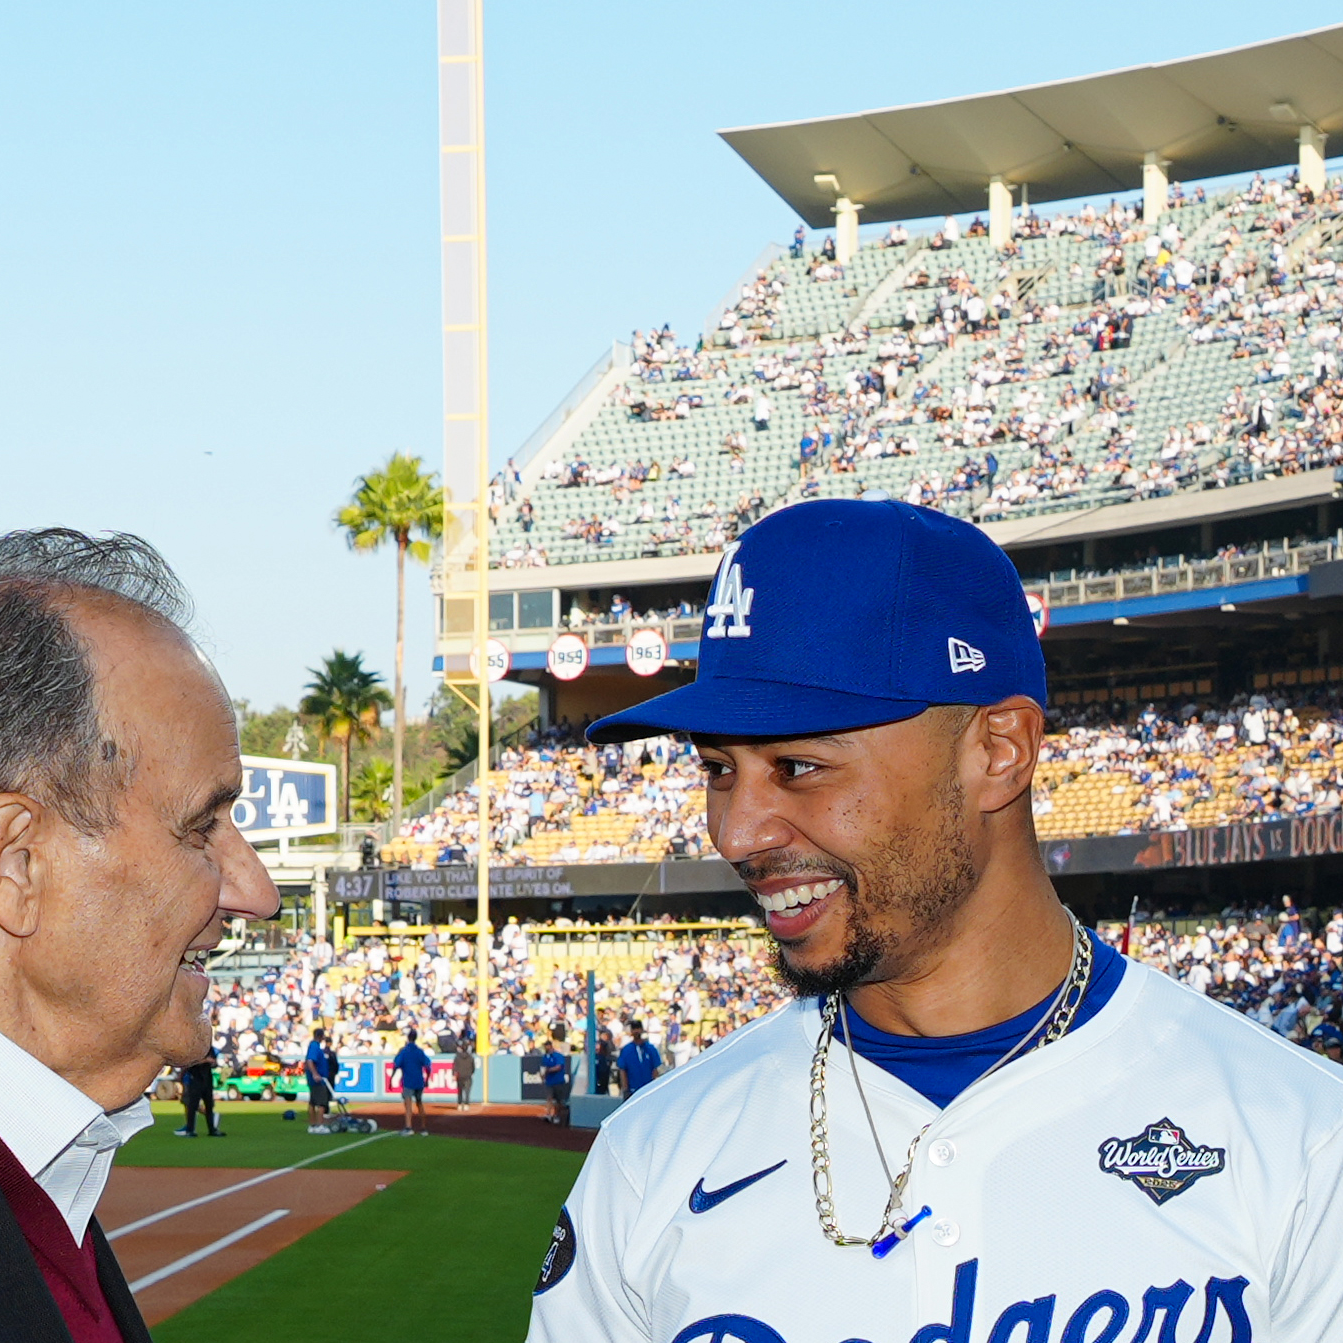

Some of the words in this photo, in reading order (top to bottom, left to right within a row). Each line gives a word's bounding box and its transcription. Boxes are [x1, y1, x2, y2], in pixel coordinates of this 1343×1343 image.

[706, 540, 755, 639] LA
[552, 648, 583, 665] 1959
[630, 644, 662, 661] 1963
[266, 769, 309, 827] LA
[1173, 826, 1217, 868] BLUE
[1219, 822, 1264, 866] JAYS
[334, 875, 374, 897] 4:37
[415, 871, 442, 884] YOU
[545, 867, 564, 880] OF
[385, 886, 446, 900] ROBERTO
[1103, 1140, 1168, 1170] World
[1157, 1145, 1220, 1178] Series
